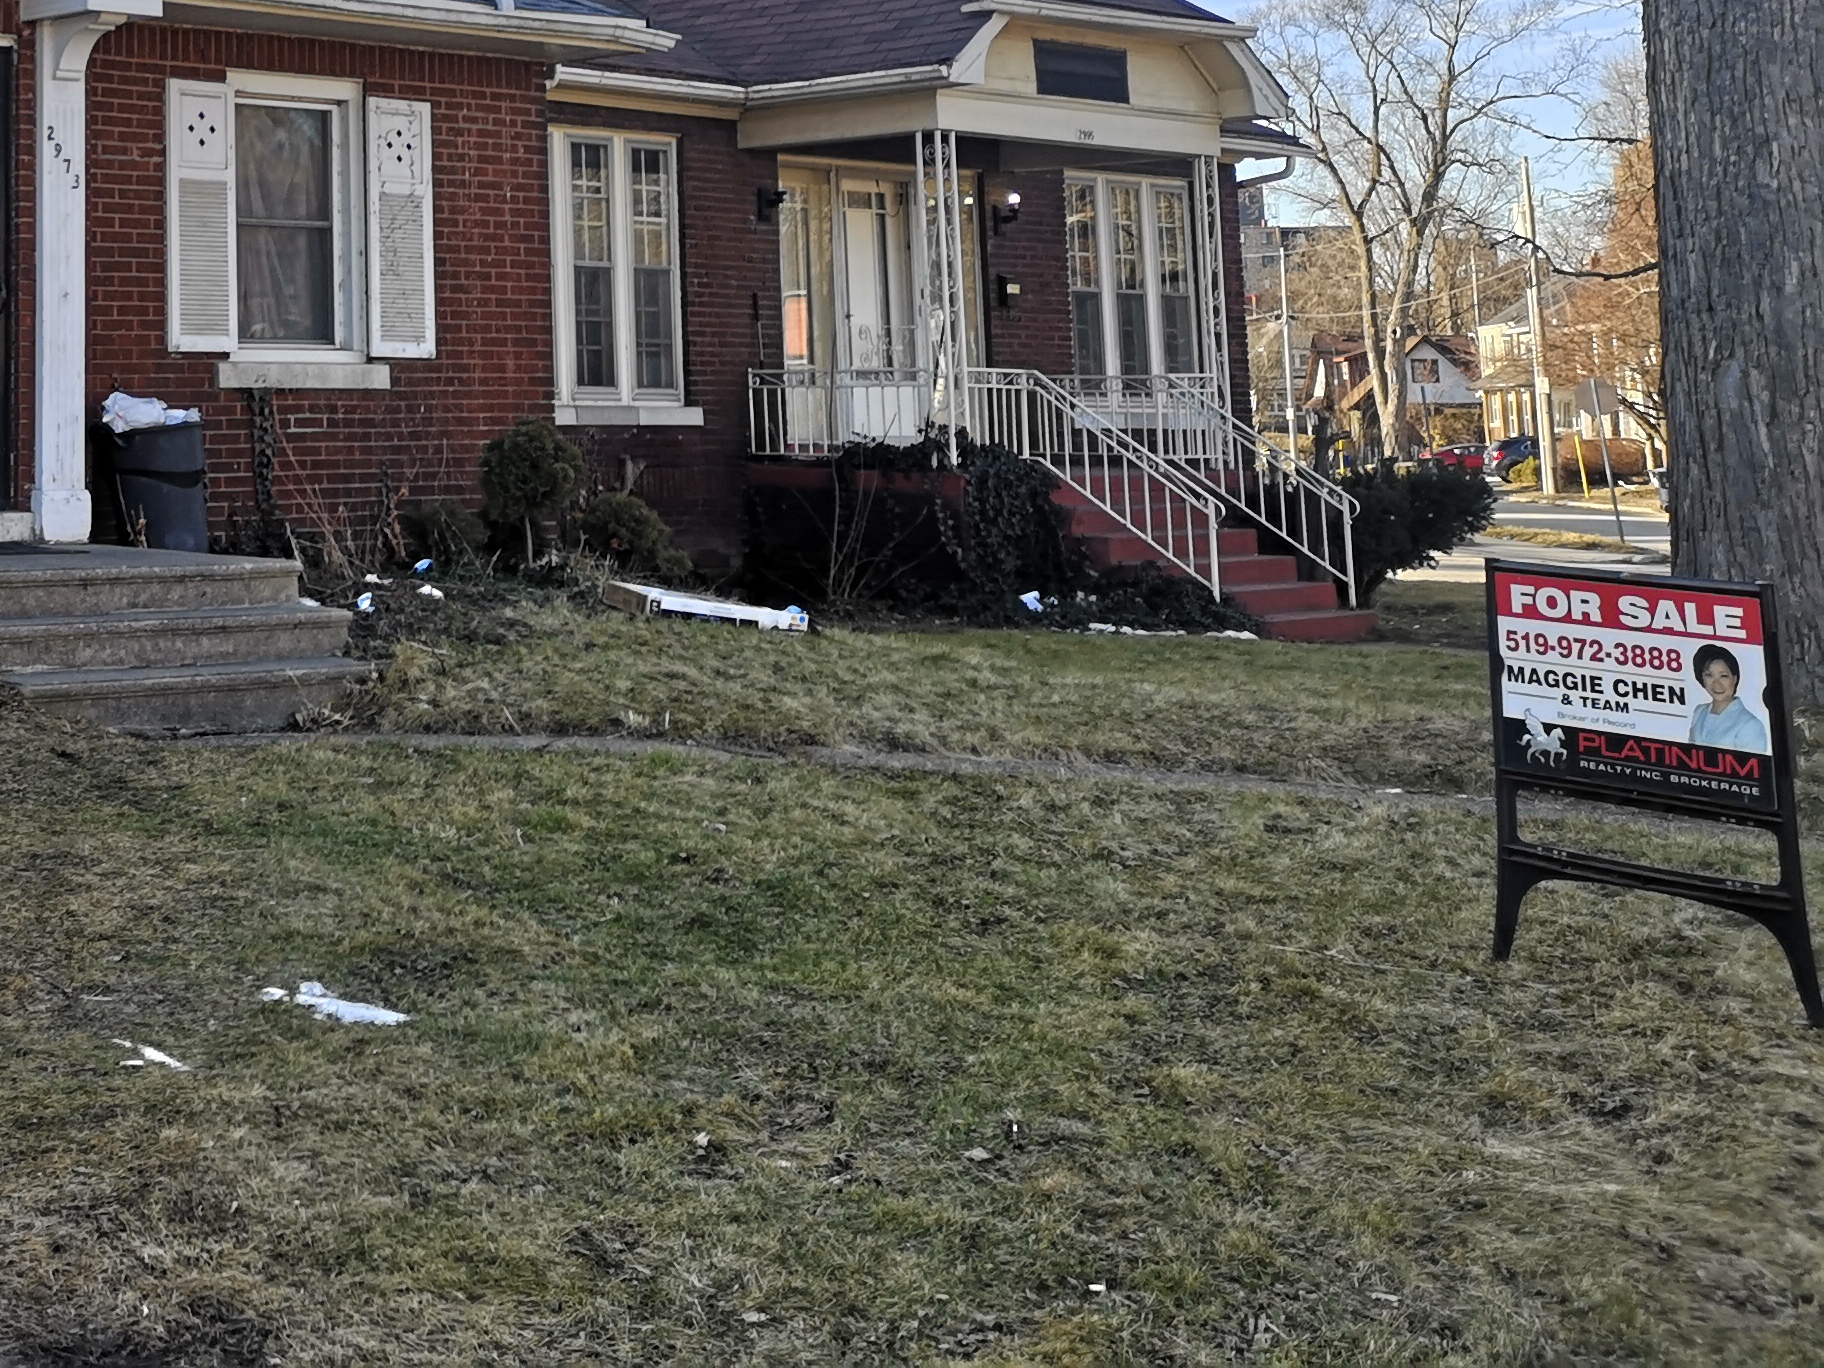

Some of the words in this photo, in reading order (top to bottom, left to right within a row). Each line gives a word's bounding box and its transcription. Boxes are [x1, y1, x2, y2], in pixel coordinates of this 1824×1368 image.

[46, 125, 80, 190] 2973
[1510, 584, 1602, 623] FOR
[1617, 598, 1747, 639] SALE
[1505, 630, 1683, 673] 519-972-3888
[1506, 664, 1604, 695] MAGGIE
[1611, 679, 1687, 706] CHEN
[1561, 693, 1573, 706] &
[1579, 696, 1630, 714] TEAM
[1557, 711, 1588, 723] Broker
[1591, 715, 1600, 724] of
[1602, 718, 1636, 730] Record
[1578, 732, 1760, 779] PLATINUM
[1579, 760, 1632, 775] REALTY
[1636, 769, 1664, 781] INC.
[1670, 774, 1761, 796] BROKERAGE
